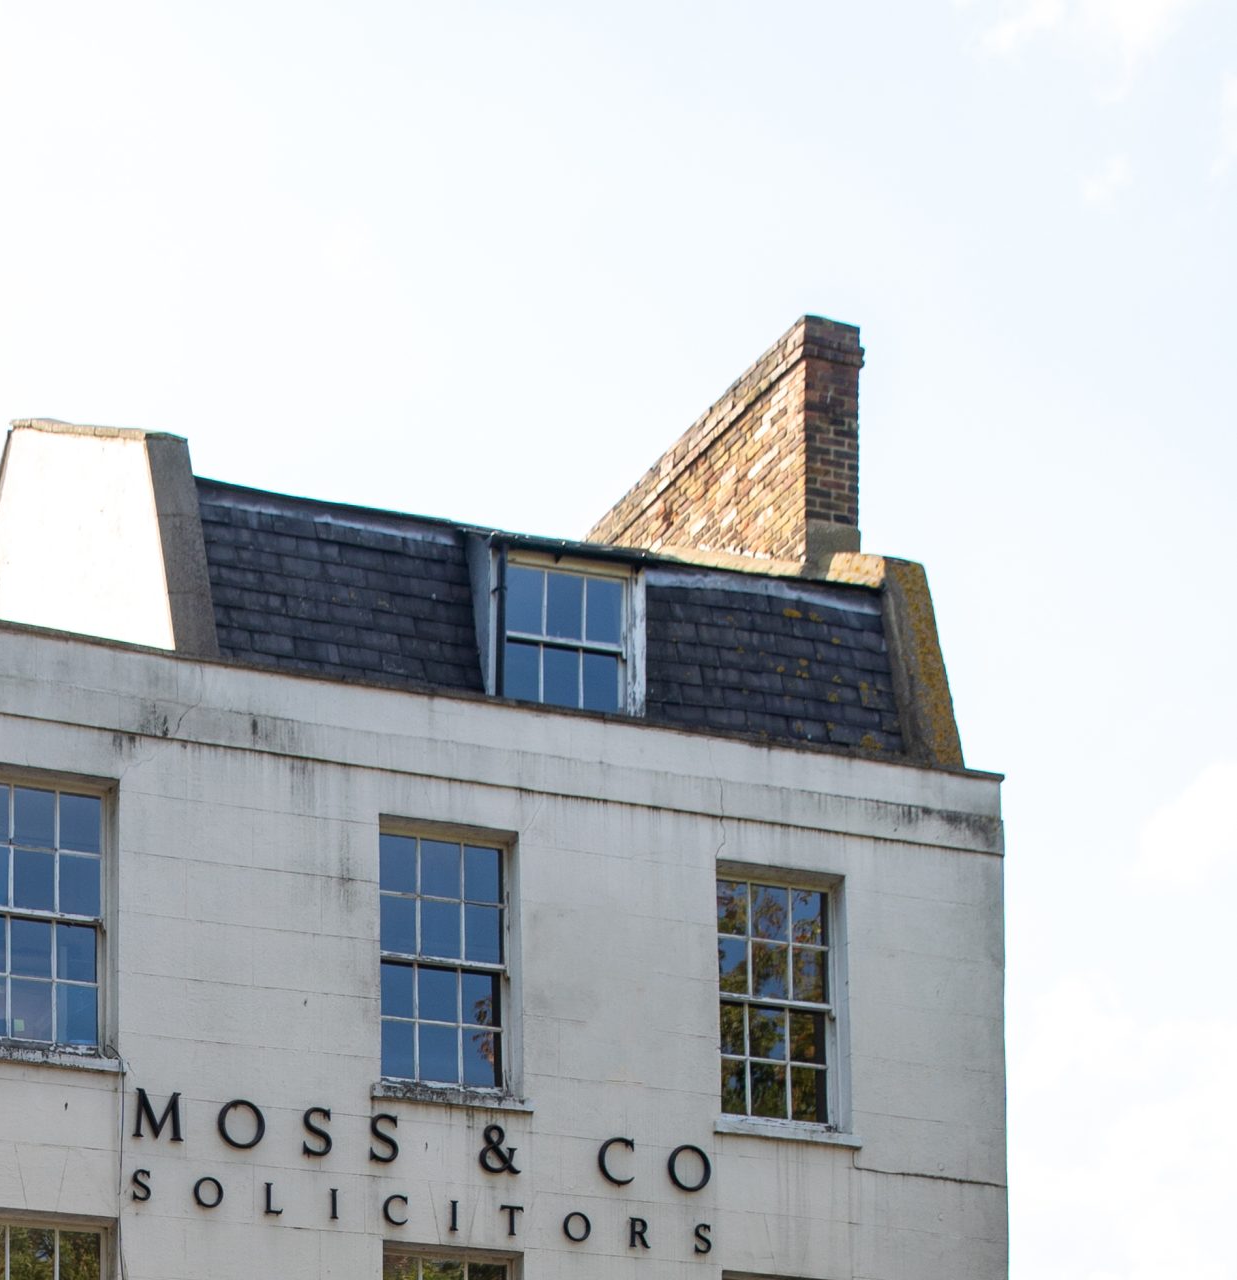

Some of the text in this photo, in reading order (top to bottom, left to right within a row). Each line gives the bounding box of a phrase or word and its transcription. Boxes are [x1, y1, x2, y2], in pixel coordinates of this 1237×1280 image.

[132, 1088, 712, 1193] MOSS & CO
[131, 1169, 713, 1254] SOLICITORS
